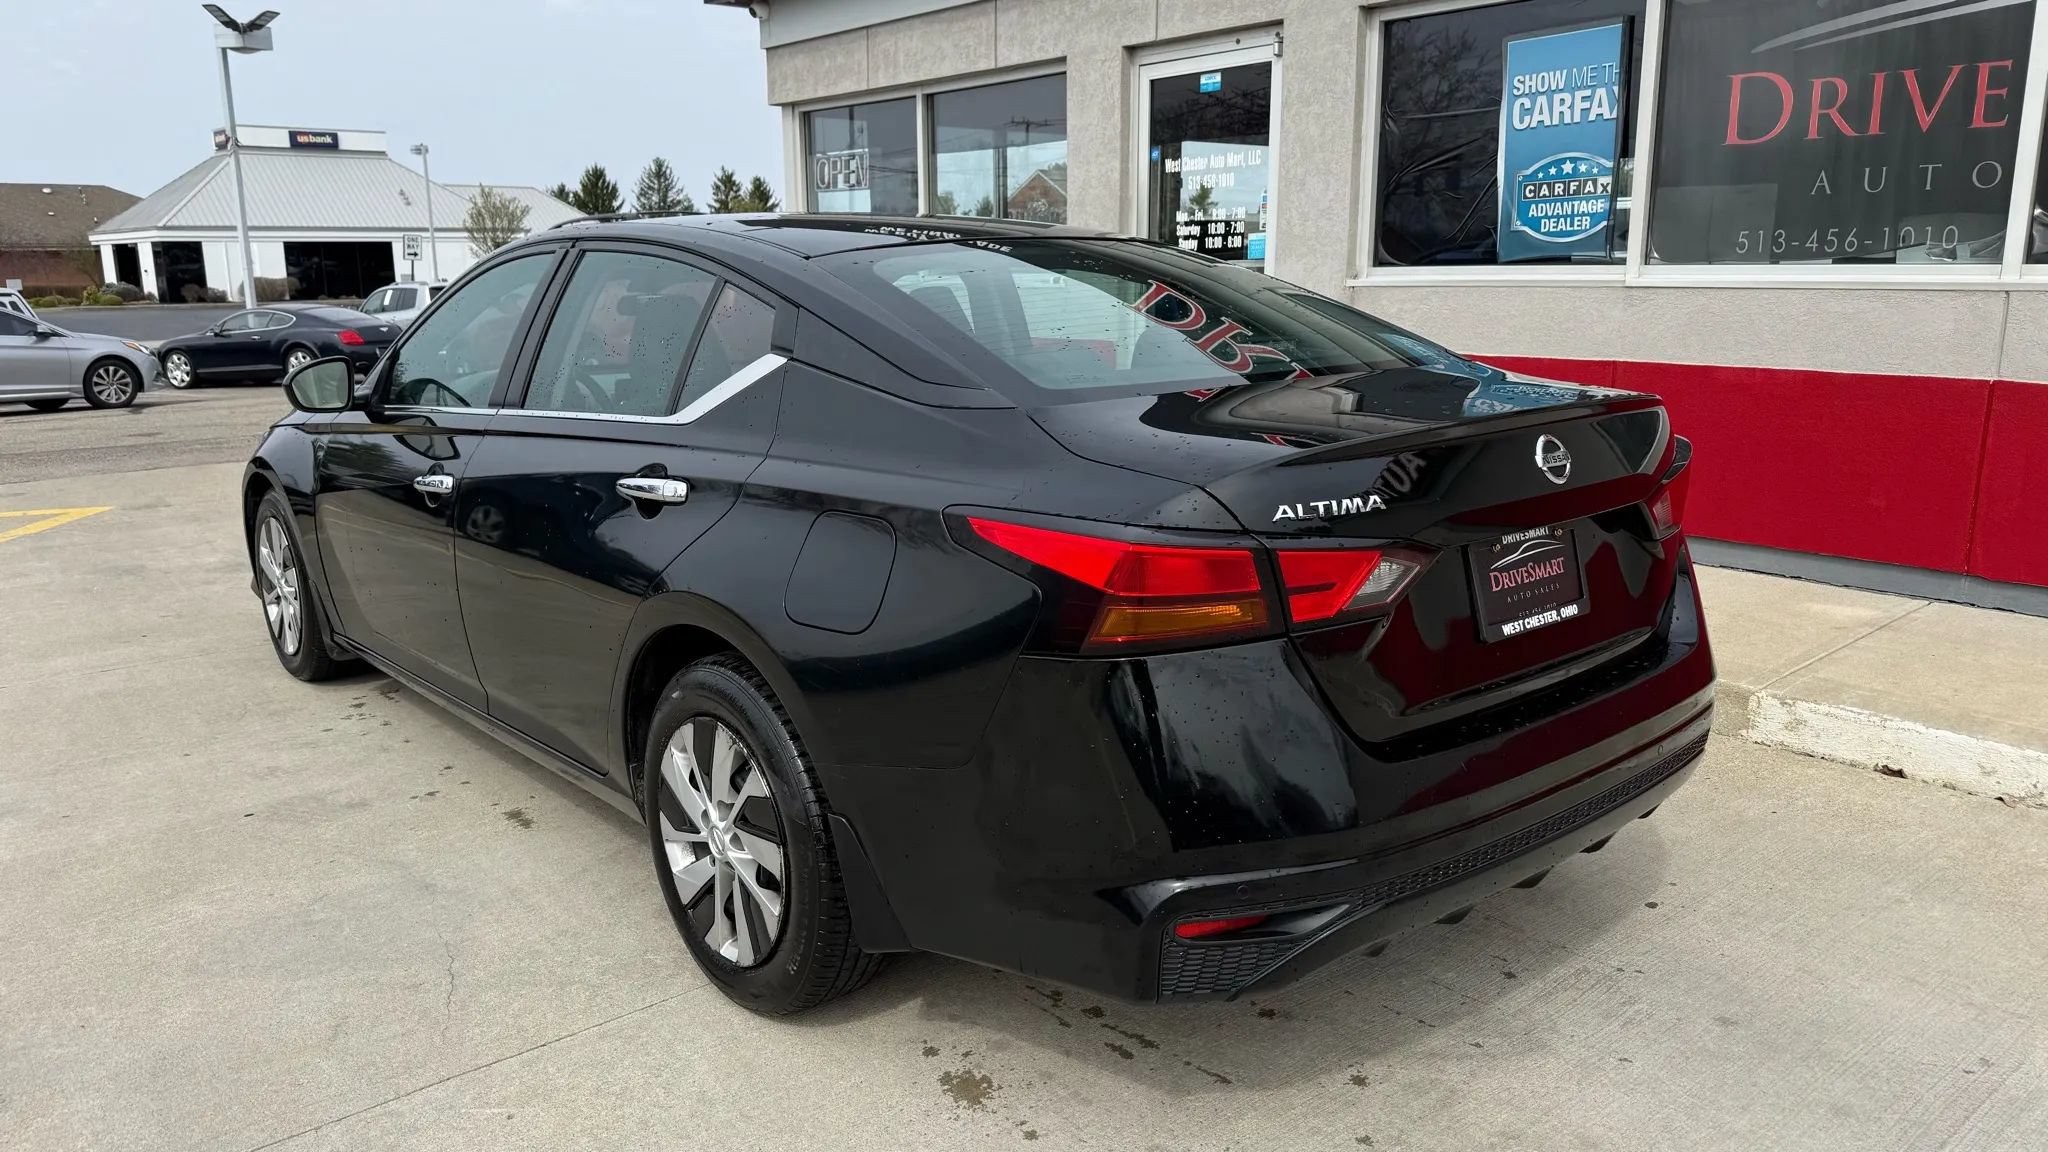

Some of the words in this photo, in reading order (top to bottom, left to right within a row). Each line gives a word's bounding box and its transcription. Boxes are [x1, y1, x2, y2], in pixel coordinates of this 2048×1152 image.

[1513, 69, 1567, 96] SHOW
[1572, 64, 1598, 88] ME
[1721, 58, 2013, 146] DRIVE
[816, 154, 867, 189] OPEN
[1165, 158, 1181, 173] West
[1182, 156, 1207, 172] Chester
[1209, 153, 1225, 169] Auto
[1227, 151, 1246, 168] Mart,
[1248, 149, 1261, 165] LLC
[1525, 178, 1611, 199] CARFAX
[1811, 160, 2003, 195] AUTO
[1528, 198, 1605, 218] ADVANTAGE
[1176, 224, 1200, 237] Saturday
[1208, 222, 1225, 234] 10:00
[1230, 221, 1245, 233] 7:00
[1540, 216, 1591, 233] DEALER
[1178, 238, 1198, 251] Sunday
[1205, 236, 1222, 249] 10:00
[1736, 225, 1958, 254] 513-456-1010
[1272, 495, 1387, 522] ALTIMA
[1501, 526, 1549, 544] DRIVESMART
[1507, 590, 1531, 603] AUTO
[1535, 583, 1560, 596] SALES
[1502, 620, 1524, 636] WEST
[1524, 609, 1560, 630] CHESTER,
[1560, 604, 1578, 619] OHIO
